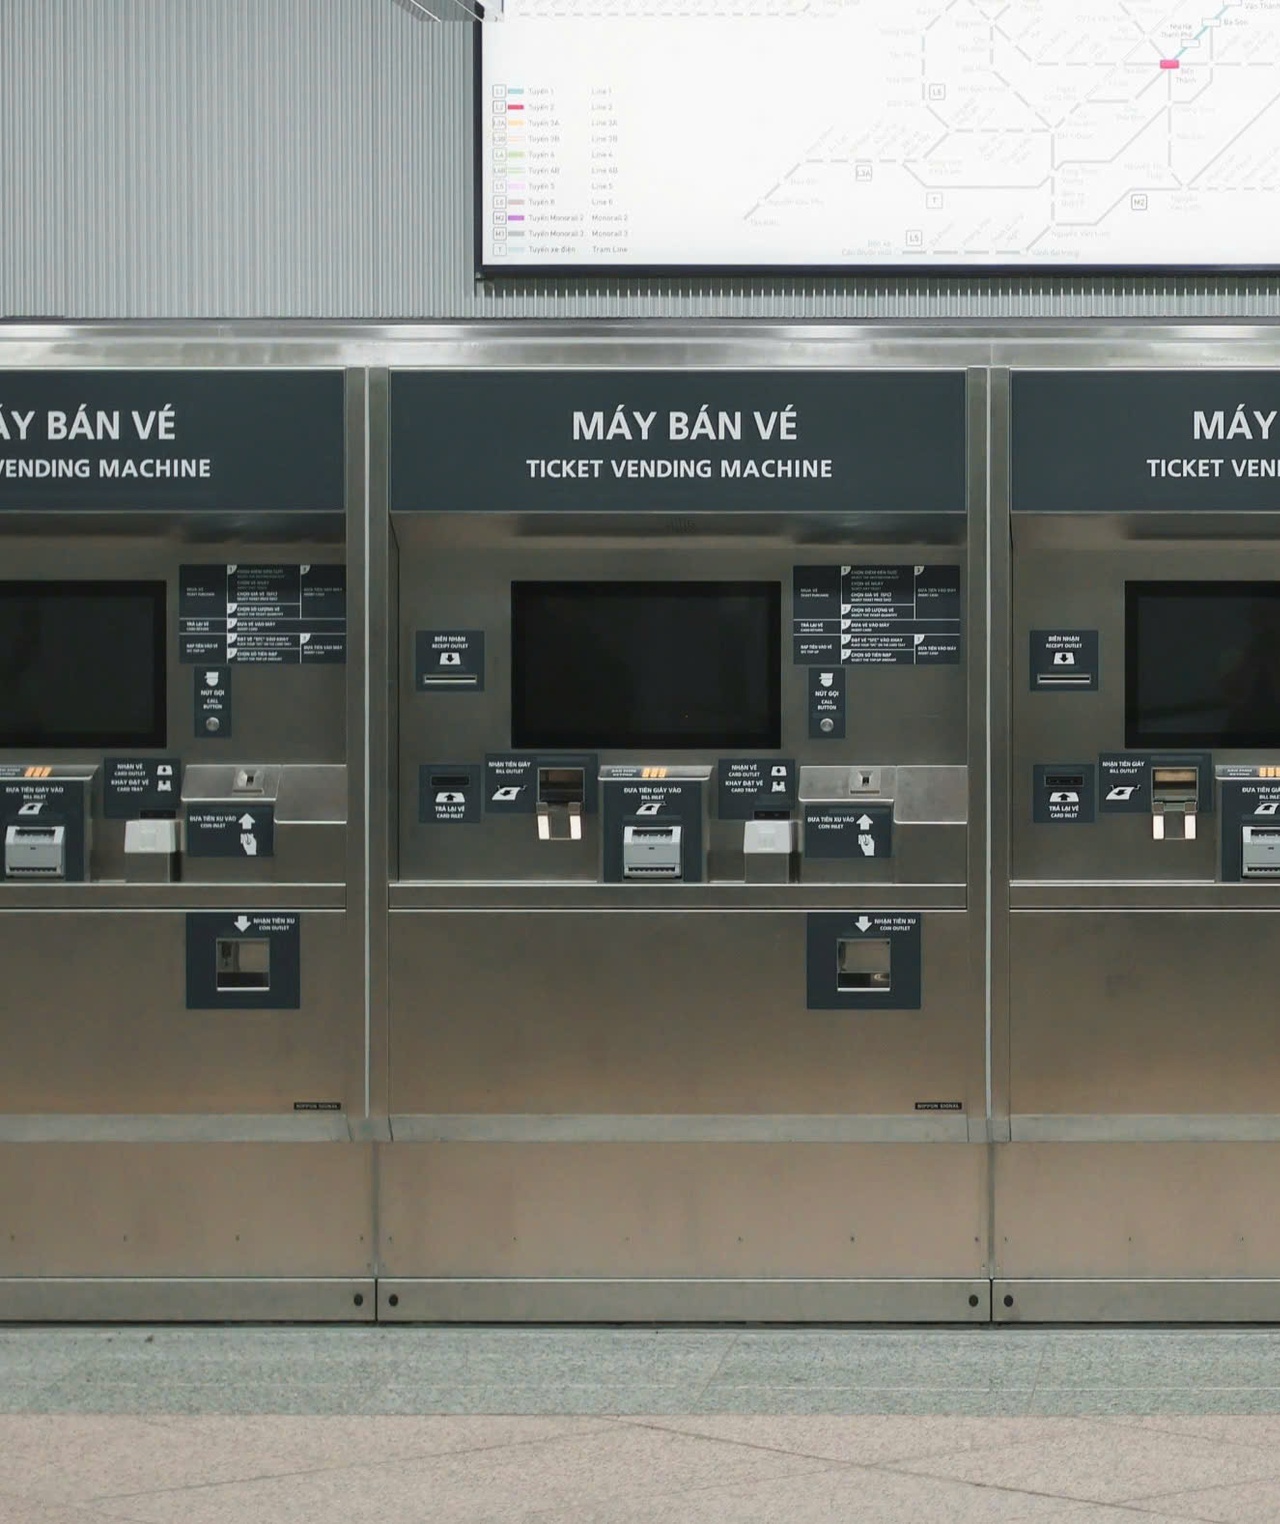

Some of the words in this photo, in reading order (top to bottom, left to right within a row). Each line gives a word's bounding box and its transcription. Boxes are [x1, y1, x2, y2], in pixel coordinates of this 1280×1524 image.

[592, 245, 611, 253] Tram
[48, 404, 119, 440] BÁN
[132, 403, 175, 440] VÉ
[573, 405, 656, 440] MÁY
[669, 404, 741, 440] BÁN
[754, 404, 797, 440] VÉ
[1194, 404, 1277, 440] MÁY
[0, 459, 90, 478] ENDING
[99, 459, 211, 478] MACHINE
[526, 459, 603, 478] TICKET
[611, 459, 712, 478] VENDING
[721, 459, 832, 478] MACHINE
[1146, 459, 1224, 477] TICKET
